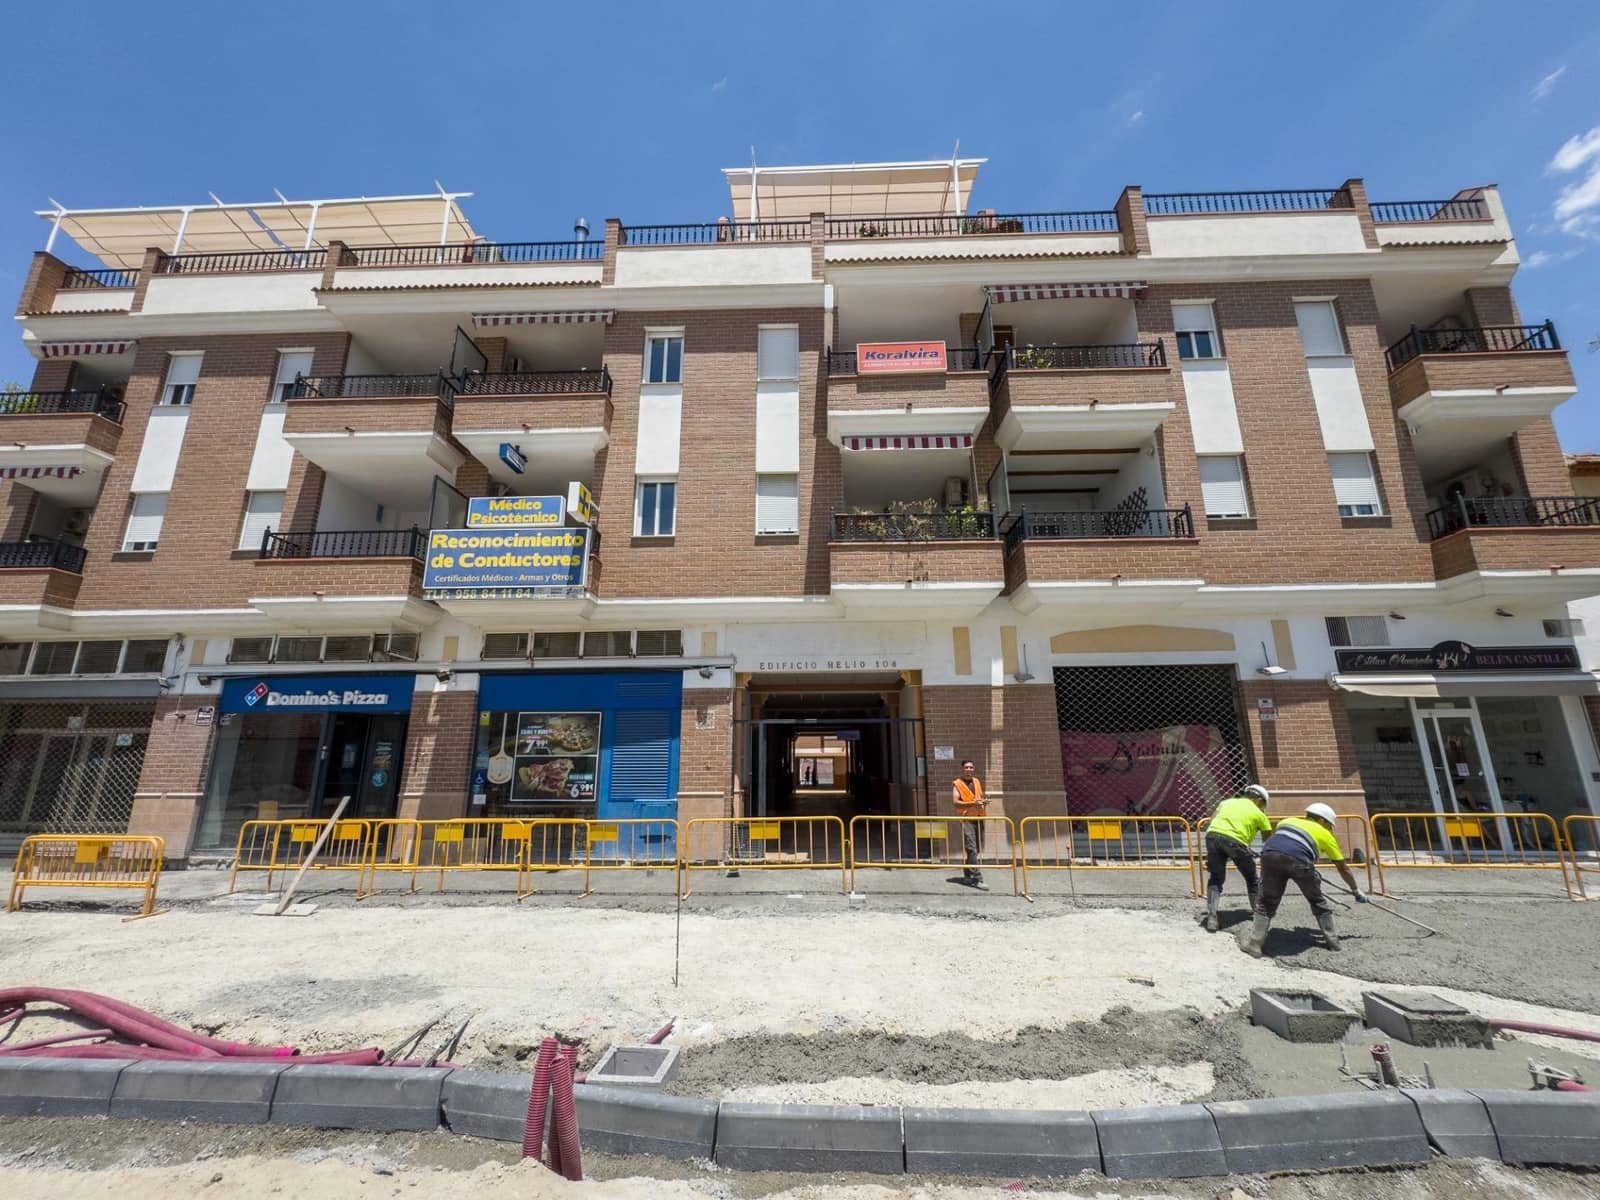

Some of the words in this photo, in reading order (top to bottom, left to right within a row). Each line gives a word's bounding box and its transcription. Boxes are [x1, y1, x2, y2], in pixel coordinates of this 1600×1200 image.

[865, 347, 939, 360] Koralvira
[489, 499, 542, 511] Médico
[470, 511, 558, 523] Psicotécnico
[431, 532, 584, 549] Reconocimiento
[431, 553, 454, 568] de
[459, 552, 581, 568] Conductores
[434, 574, 480, 583] Certificados
[481, 573, 513, 582] Médicos
[519, 574, 545, 582] Armas
[551, 574, 574, 582] Otros
[455, 589, 477, 599] 958
[481, 588, 497, 599] 84
[502, 589, 512, 599] 11
[516, 588, 531, 599] 84
[759, 661, 817, 670] EDIFICIO
[827, 661, 866, 669] HELIO
[266, 690, 341, 706] Domino's
[342, 689, 389, 705] Pizza
